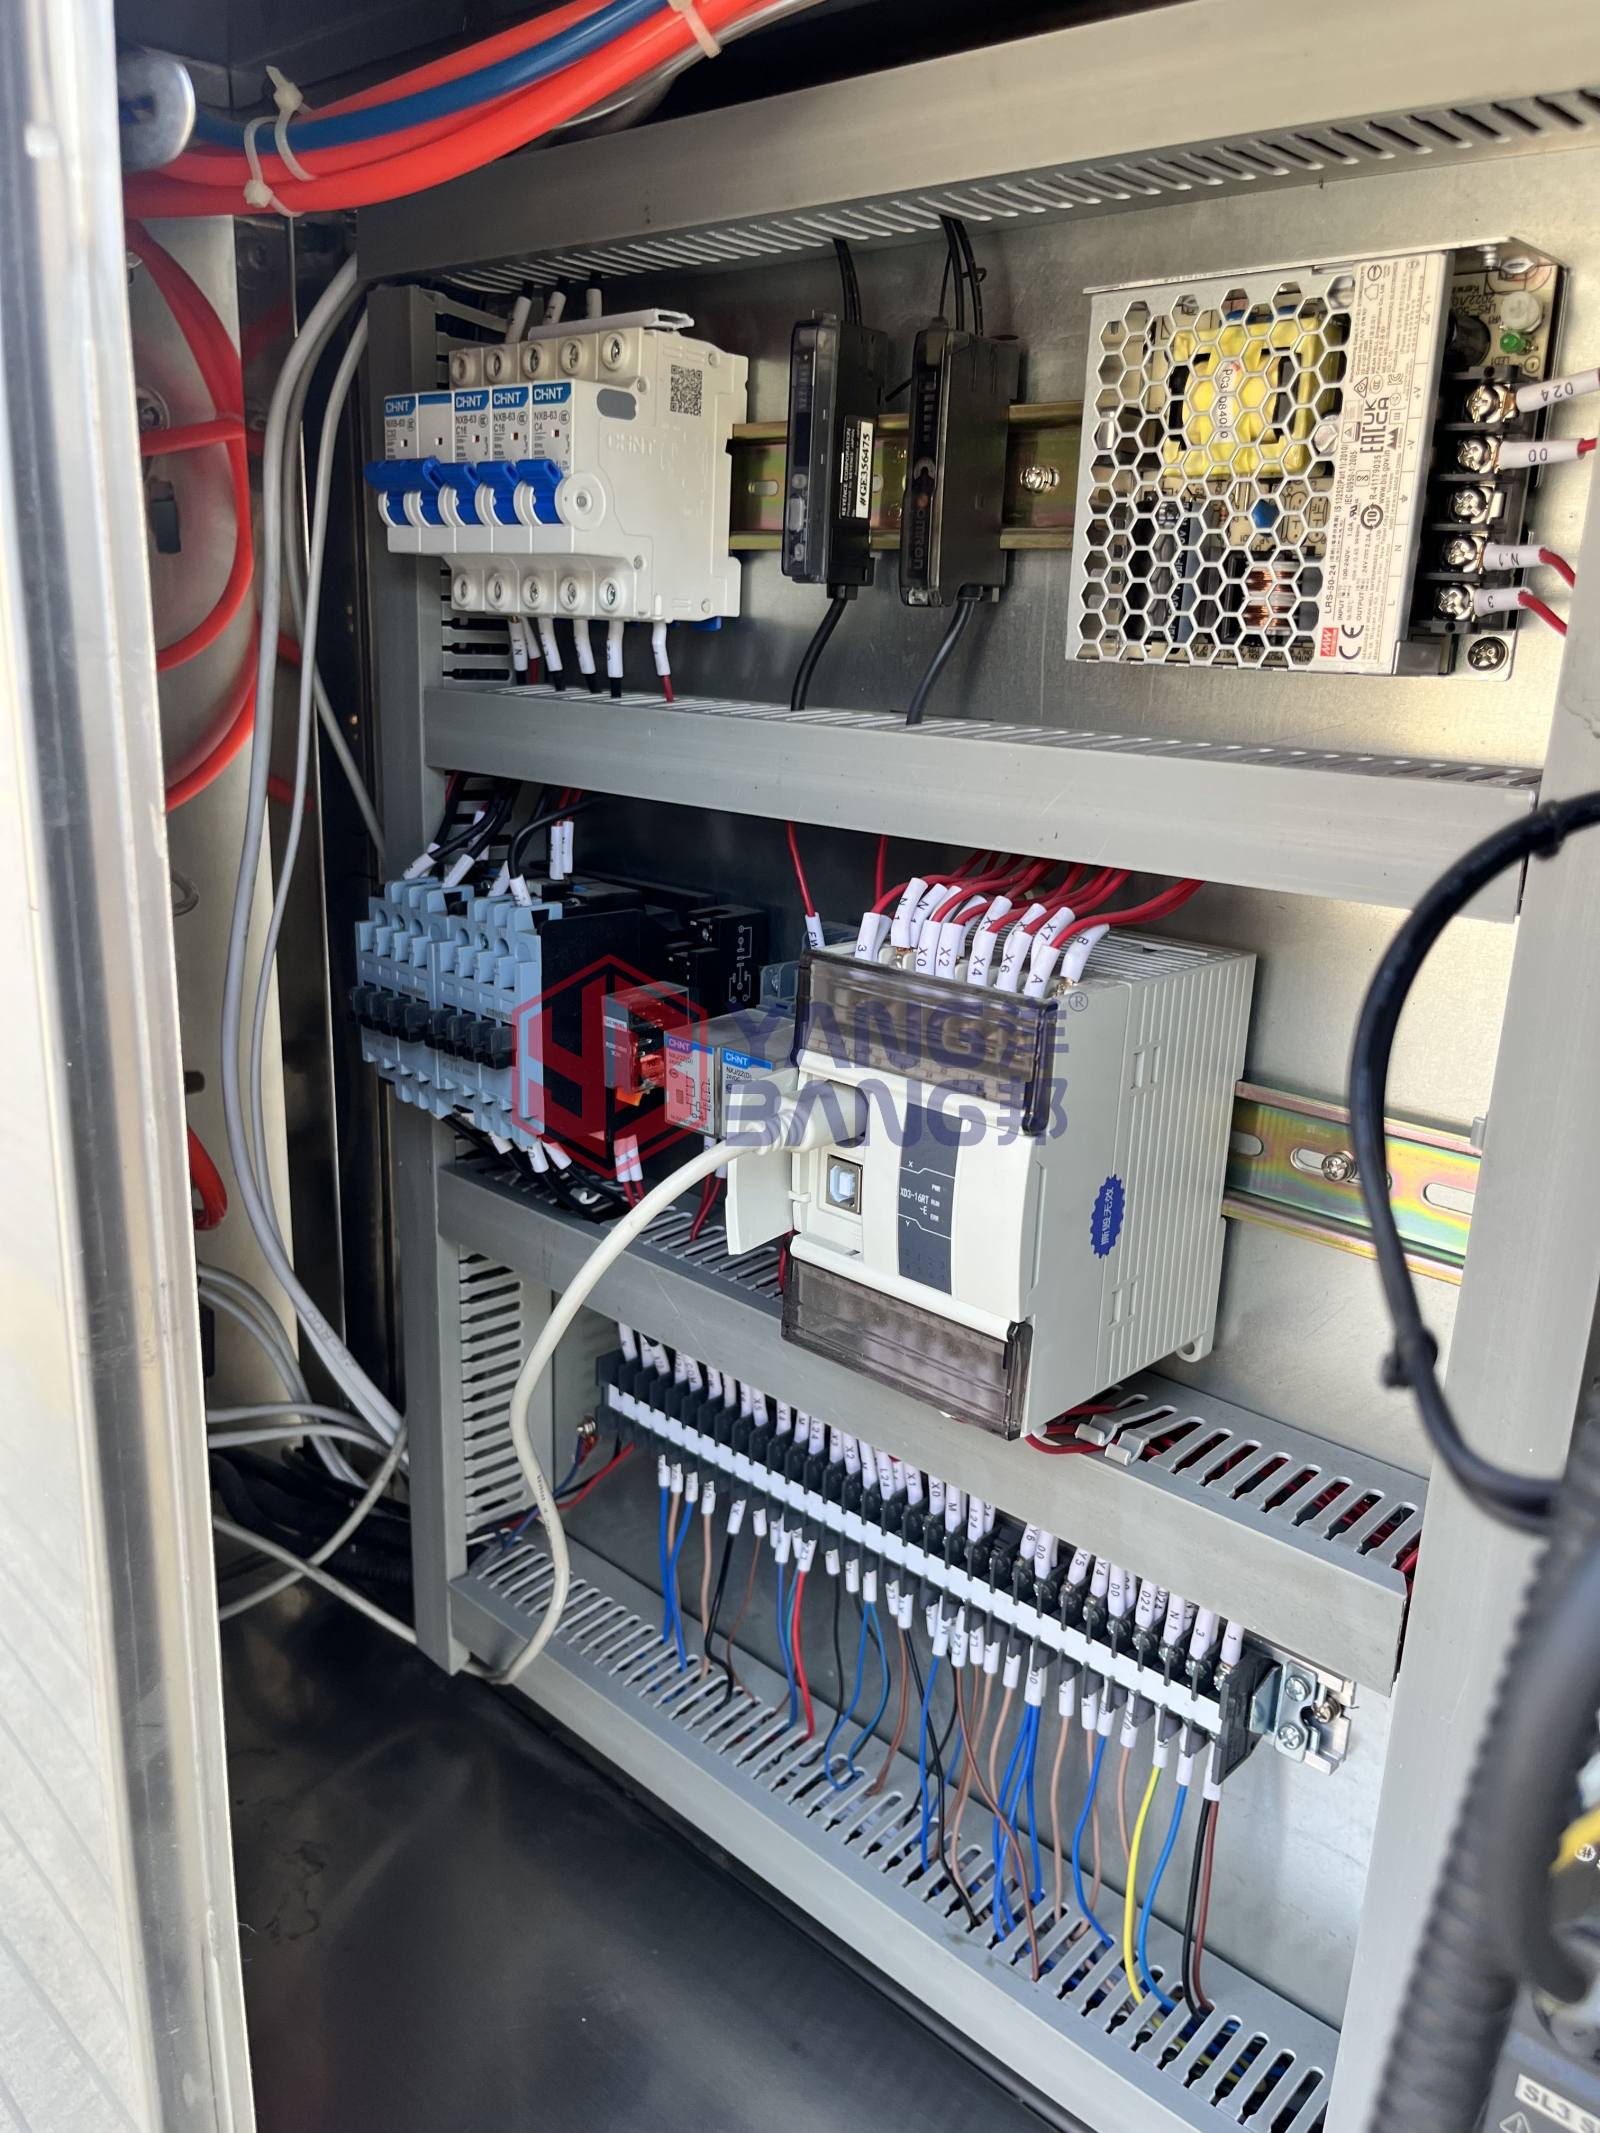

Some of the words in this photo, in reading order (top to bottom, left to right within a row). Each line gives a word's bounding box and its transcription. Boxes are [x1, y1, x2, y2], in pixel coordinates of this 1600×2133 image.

[456, 414, 477, 424] NXB-63
[494, 412, 515, 422] NXB-63
[534, 411, 557, 421] NXB-63
[860, 434, 870, 506] #GE356475
[1324, 566, 1336, 613] LRS-50-24
[1356, 592, 1364, 621] OUTPUT
[1039, 923, 1056, 942] X7
[1077, 936, 1088, 946] B
[938, 947, 951, 967] X2
[1000, 953, 1015, 973] X6
[971, 955, 986, 976] X4
[1030, 974, 1044, 984] A
[845, 1446, 855, 1460] X2
[907, 1472, 916, 1486] X1
[949, 1503, 957, 1512] M
